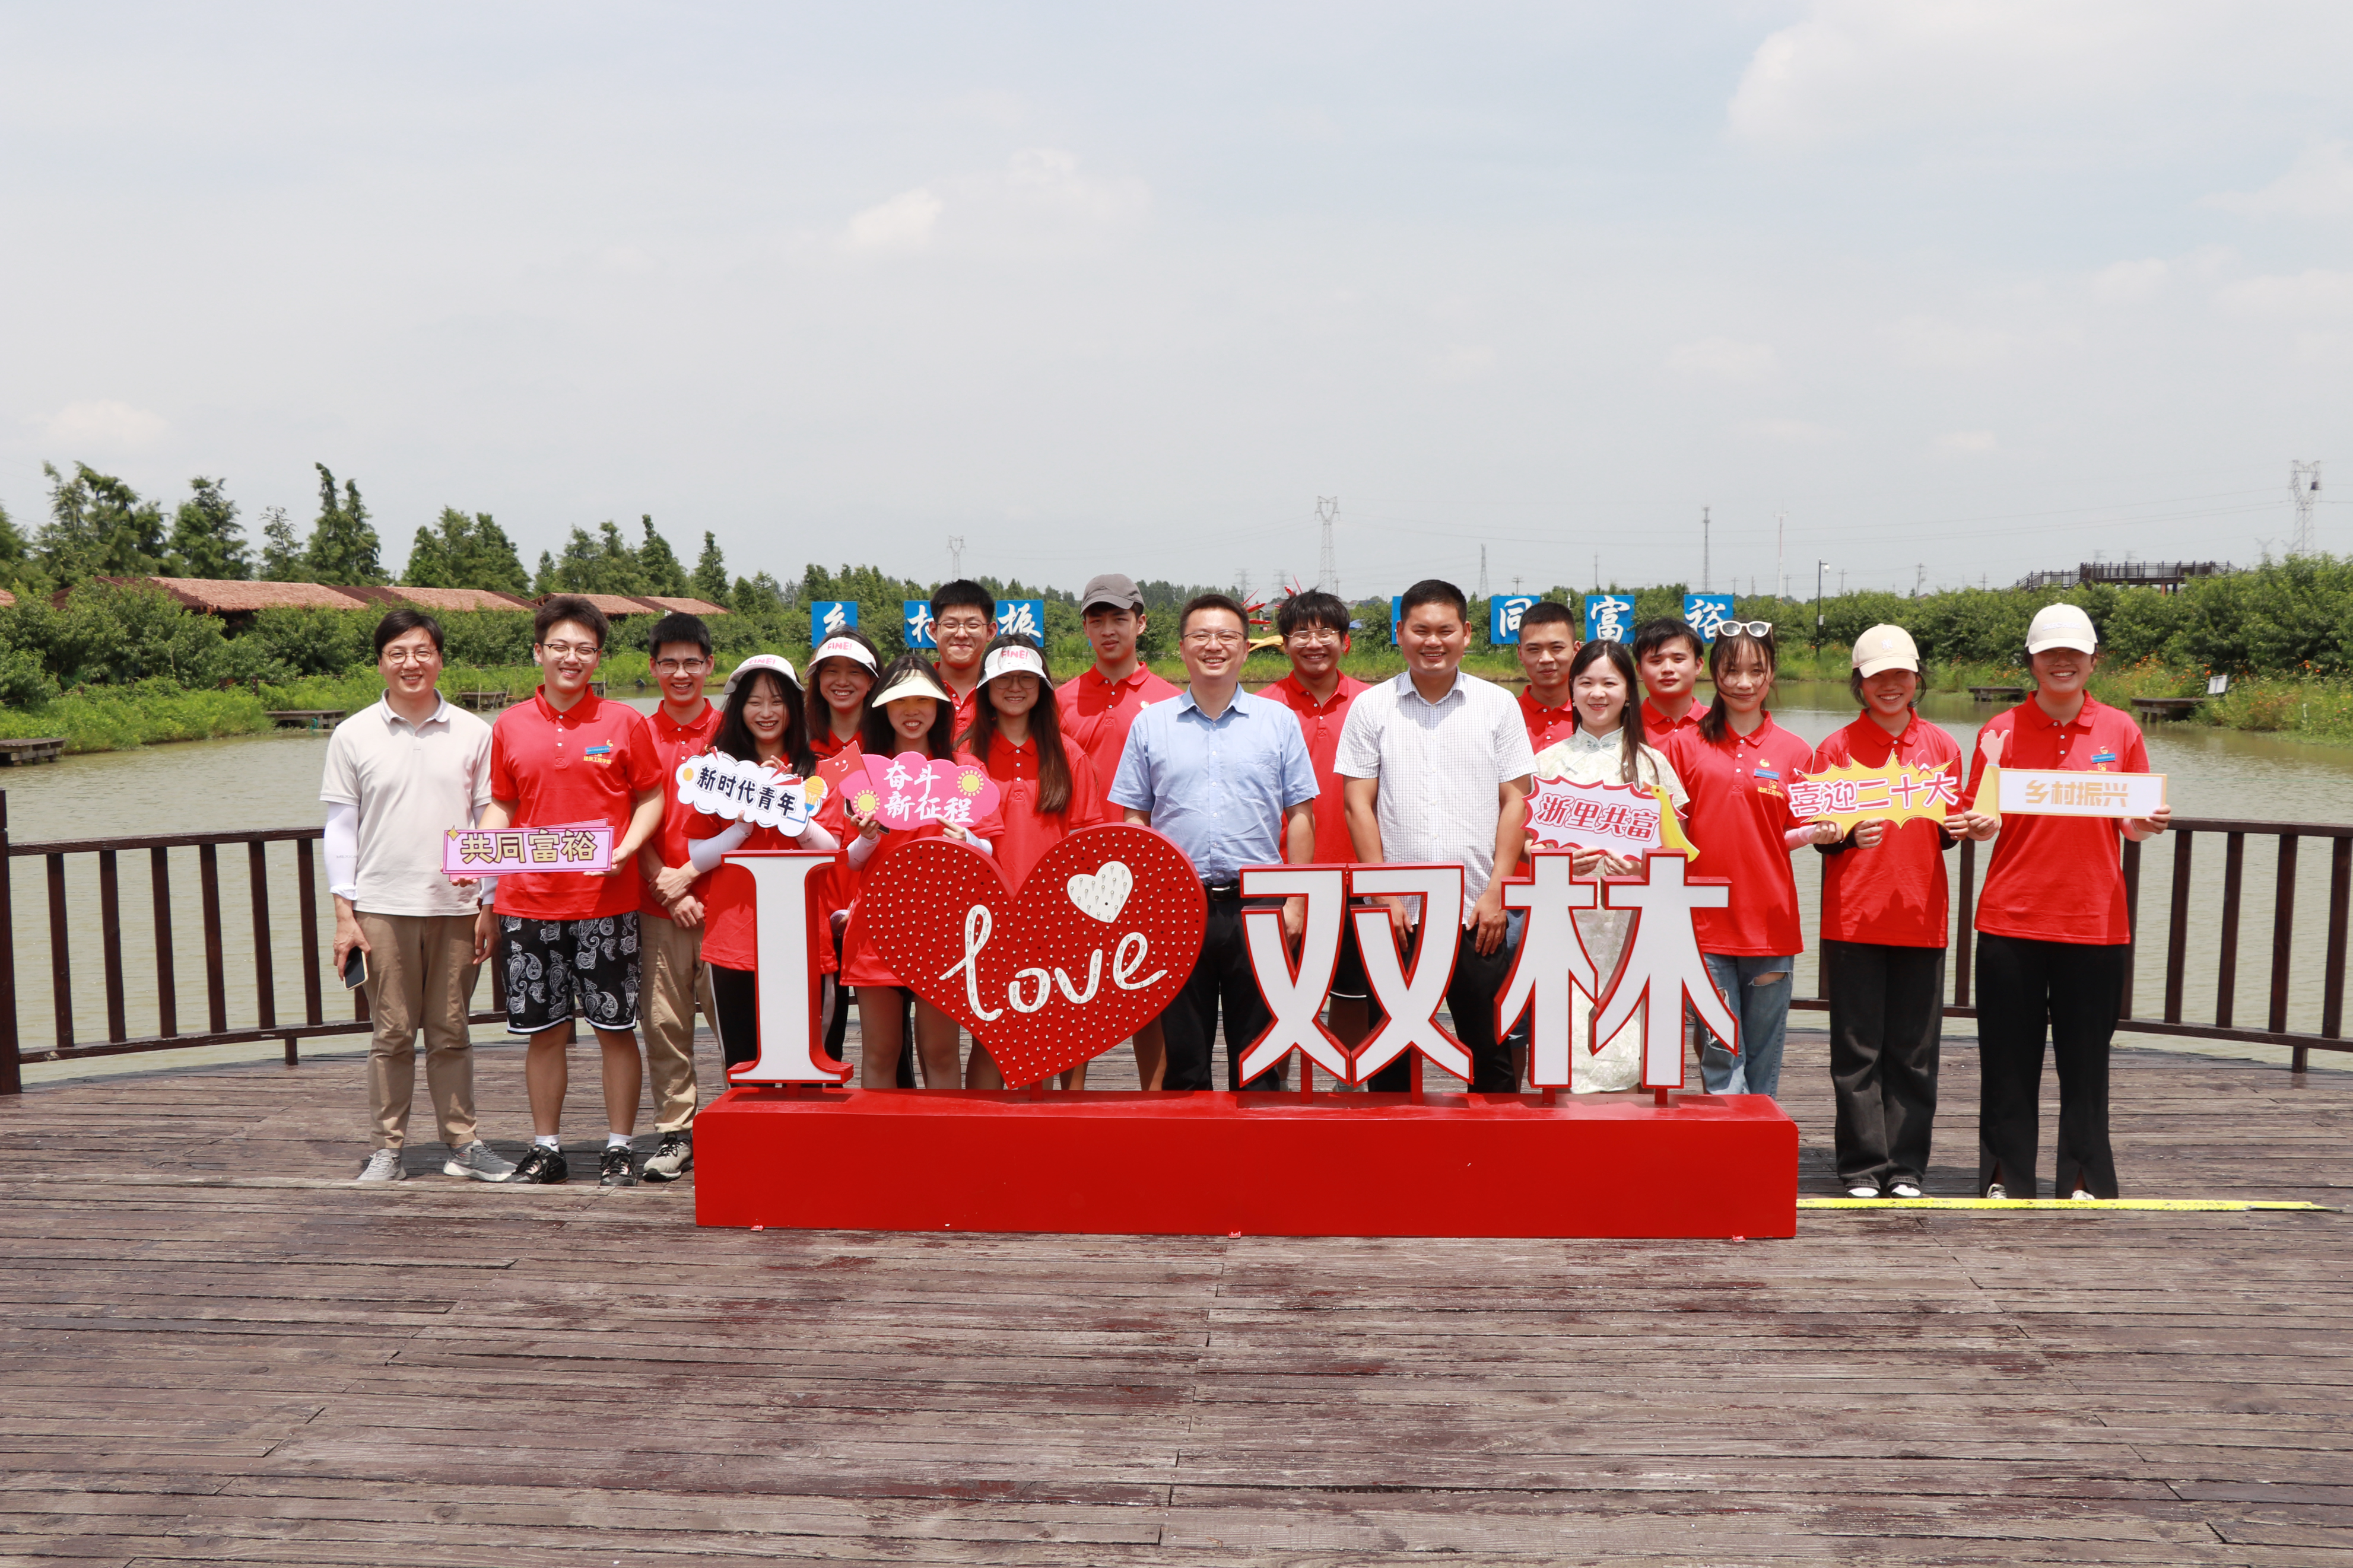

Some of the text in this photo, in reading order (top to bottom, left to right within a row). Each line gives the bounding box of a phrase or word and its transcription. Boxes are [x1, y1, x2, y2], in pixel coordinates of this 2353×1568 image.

[1590, 595, 1630, 643] 富
[1685, 599, 1726, 640] 裕
[828, 641, 852, 650] FINE!
[1001, 650, 1028, 660] FINE!
[697, 766, 796, 817] 新时代青年
[884, 761, 941, 794] 奋斗
[1788, 772, 1959, 818] 喜迎二十大
[2025, 780, 2129, 807] 乡村振兴
[884, 791, 974, 823] 新征程
[1535, 794, 1659, 841] 浙里共富
[460, 829, 597, 864] 共同富裕
[721, 851, 850, 1084] I
[939, 904, 1168, 1021] love
[1239, 848, 1739, 1089] 双林
